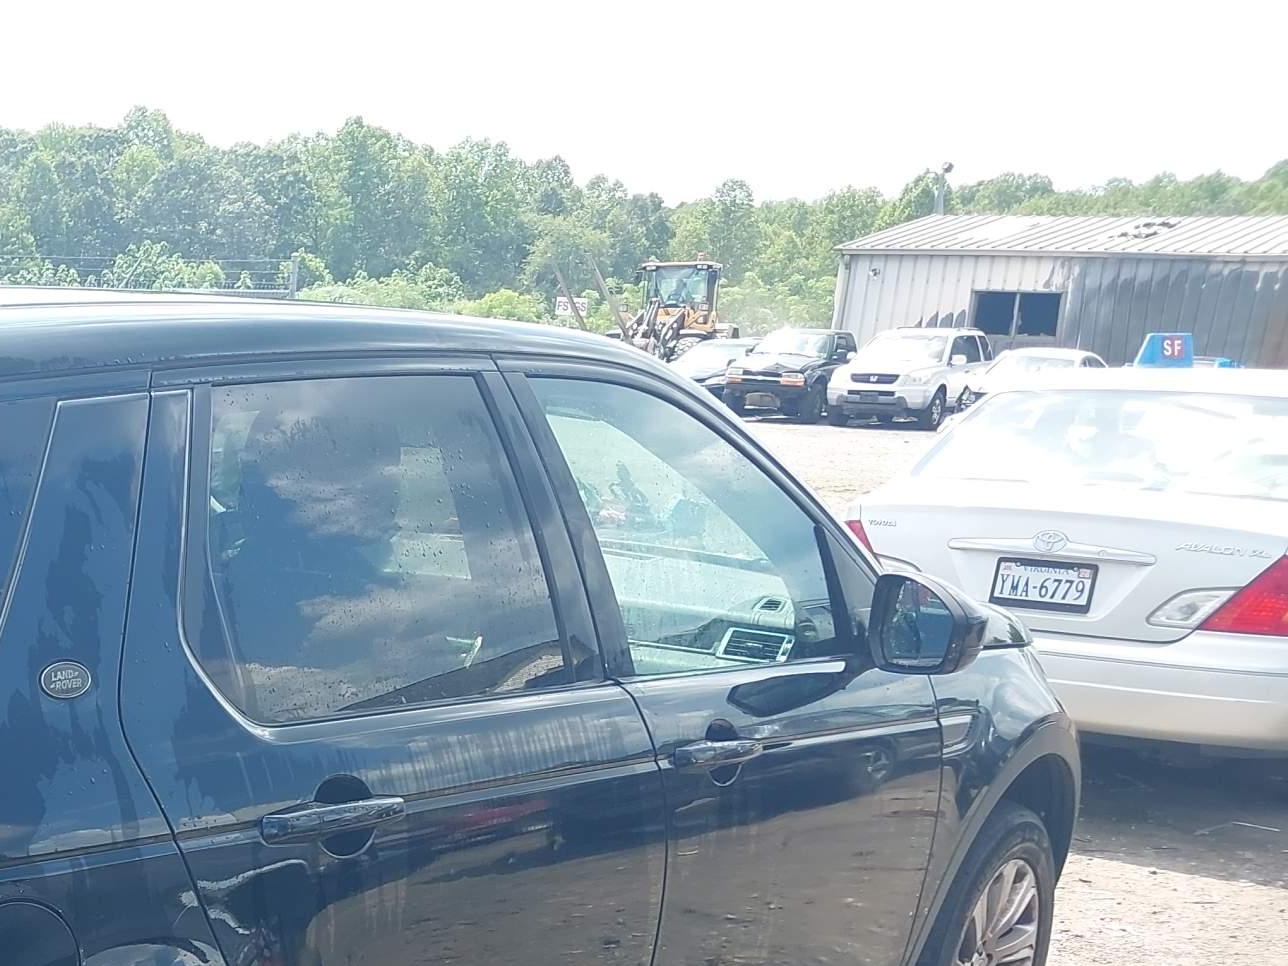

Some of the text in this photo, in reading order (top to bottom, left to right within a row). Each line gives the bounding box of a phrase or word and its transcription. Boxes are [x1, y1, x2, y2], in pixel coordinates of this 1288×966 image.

[1163, 340, 1182, 356] SF
[1175, 542, 1246, 557] AVALON
[999, 573, 1086, 601] YMA-6779
[51, 669, 74, 681] LAND
[55, 679, 82, 691] ROVER
